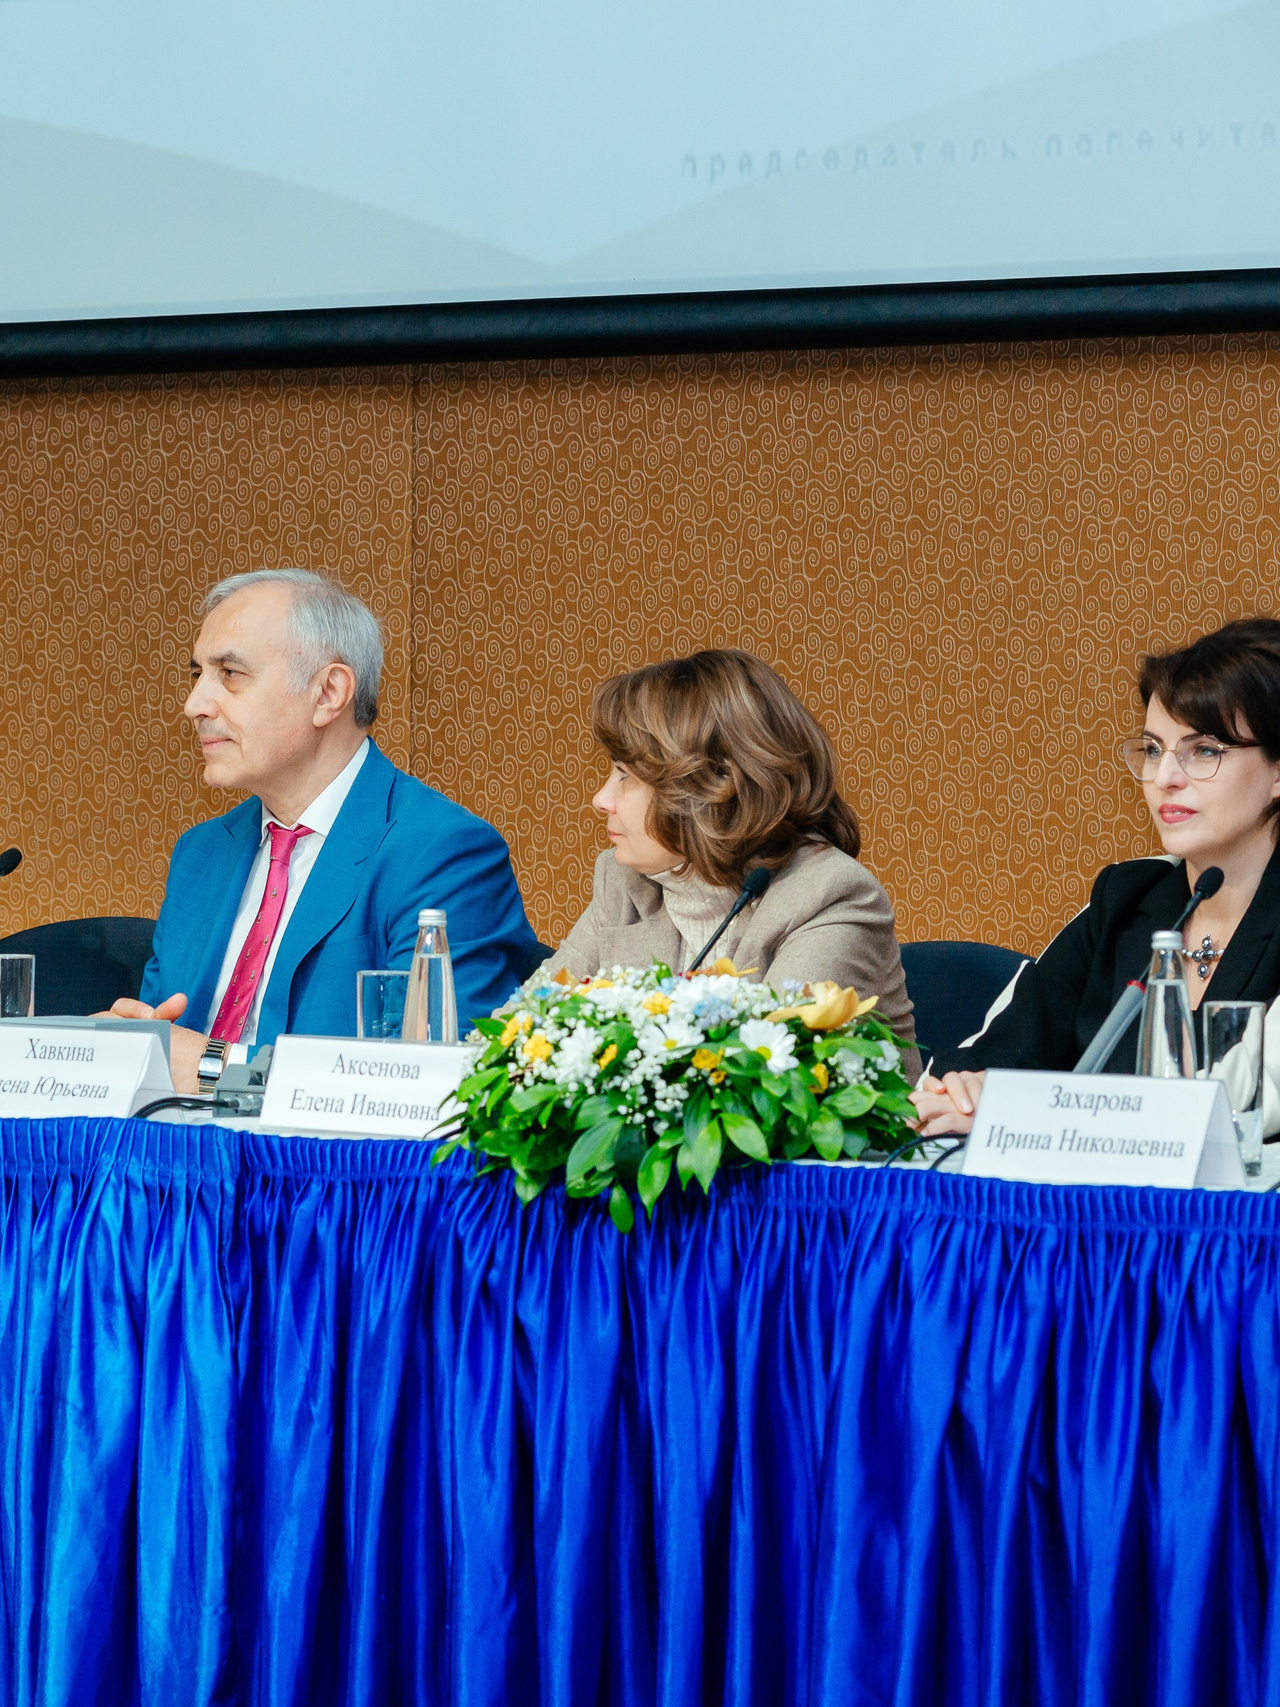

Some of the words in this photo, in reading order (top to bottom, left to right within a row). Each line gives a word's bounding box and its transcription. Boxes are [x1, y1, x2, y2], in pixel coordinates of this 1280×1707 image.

[25, 1038, 95, 1062] Хавкина
[331, 1053, 420, 1080] Аксенова
[33, 1076, 110, 1101] Юрьевна
[1048, 1084, 1143, 1117] Захарова
[290, 1088, 345, 1114] Елена
[350, 1093, 439, 1121] Ивановна
[986, 1125, 1052, 1155] Ирина
[1058, 1128, 1185, 1158] Николаевна
